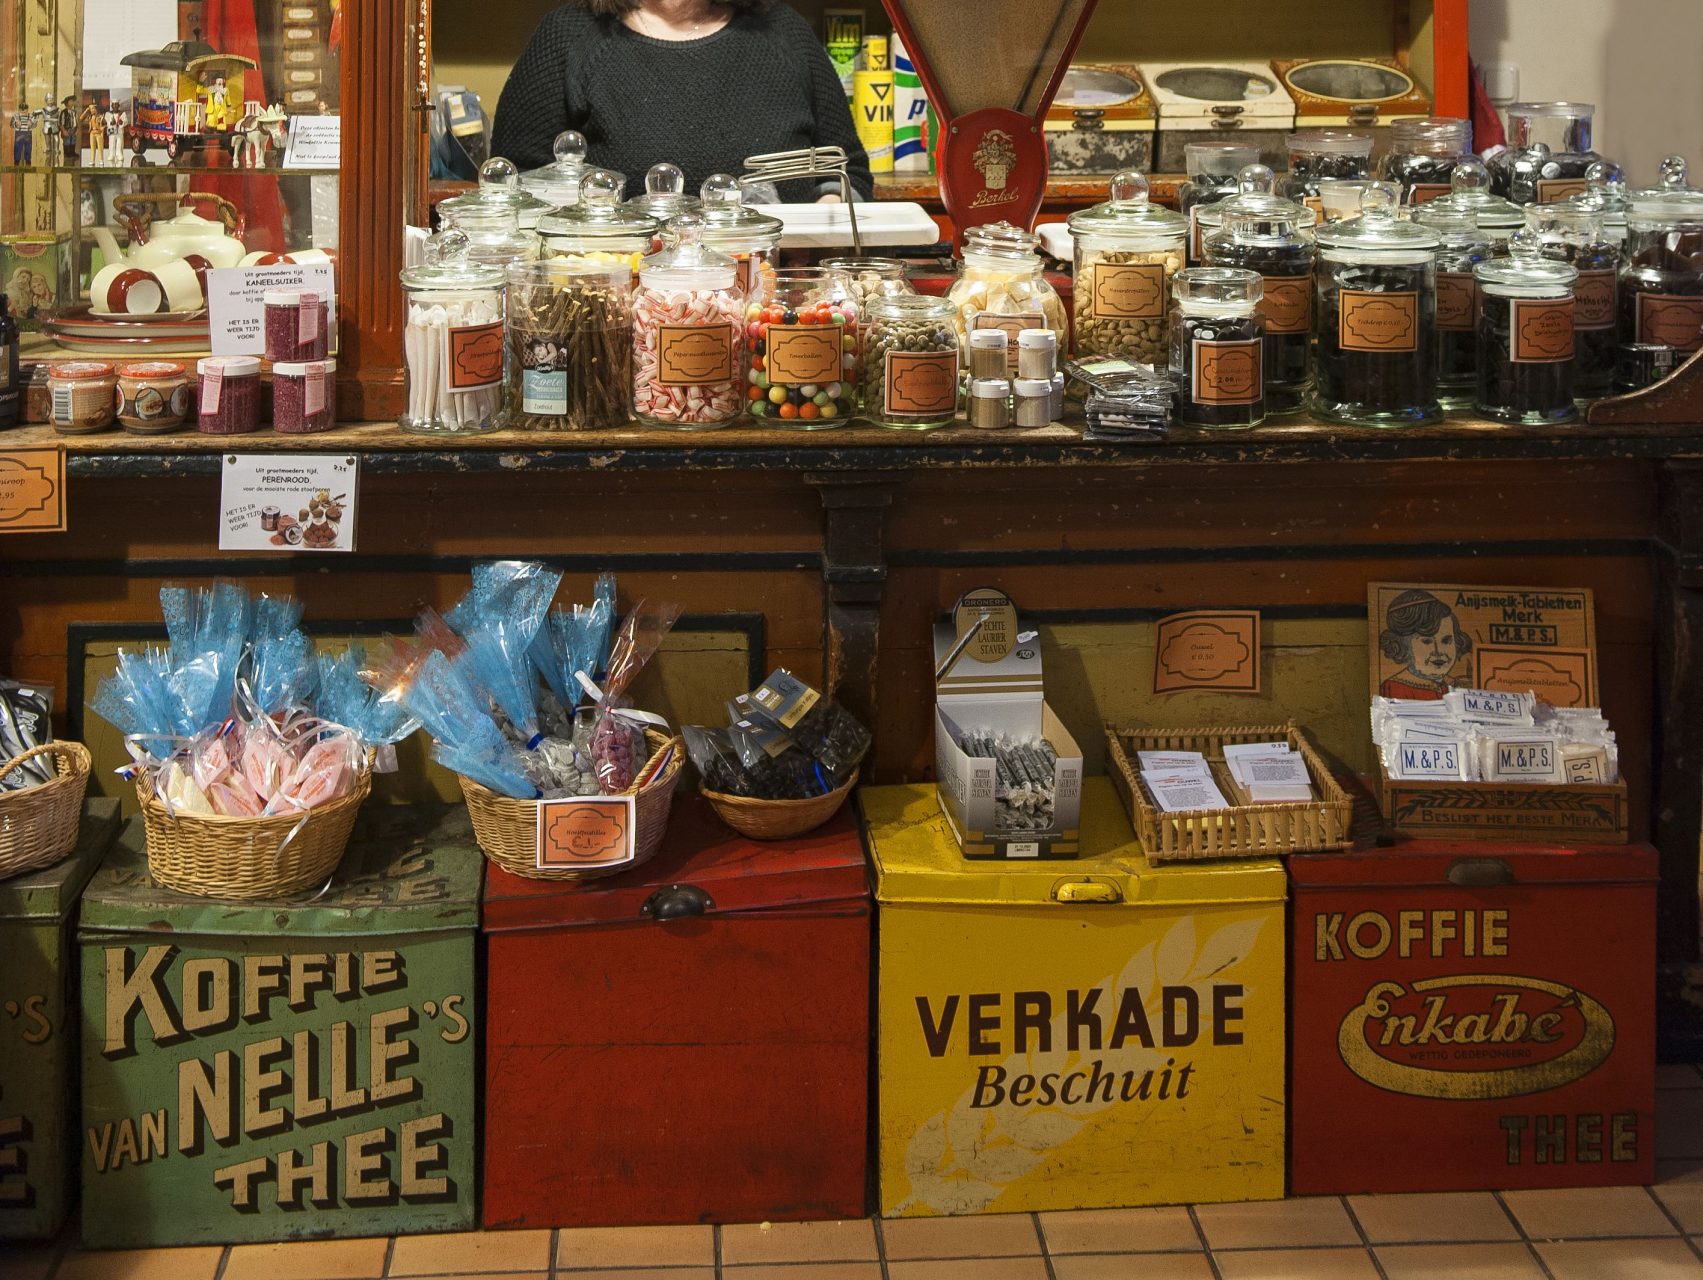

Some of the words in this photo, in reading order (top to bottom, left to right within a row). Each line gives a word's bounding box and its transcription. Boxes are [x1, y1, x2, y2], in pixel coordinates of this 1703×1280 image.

[968, 188, 1019, 208] Berkel
[255, 270, 292, 279] grootmoeders
[226, 508, 238, 517] HET
[228, 515, 246, 524] WEER
[1503, 609, 1543, 624] Merk
[983, 621, 1007, 632] ECHTE
[978, 632, 1007, 643] LAURIER
[980, 644, 1007, 655] STAVEN
[1190, 643, 1215, 651] Ouwel
[1315, 909, 1509, 962] KOFFIE
[103, 944, 400, 1056] KOFFIE
[914, 984, 1244, 1058] VERKADE
[969, 1057, 1196, 1110] Beschuit
[89, 1108, 168, 1172] VAN
[1500, 1113, 1639, 1165] THEE
[213, 1112, 450, 1207] THEE
